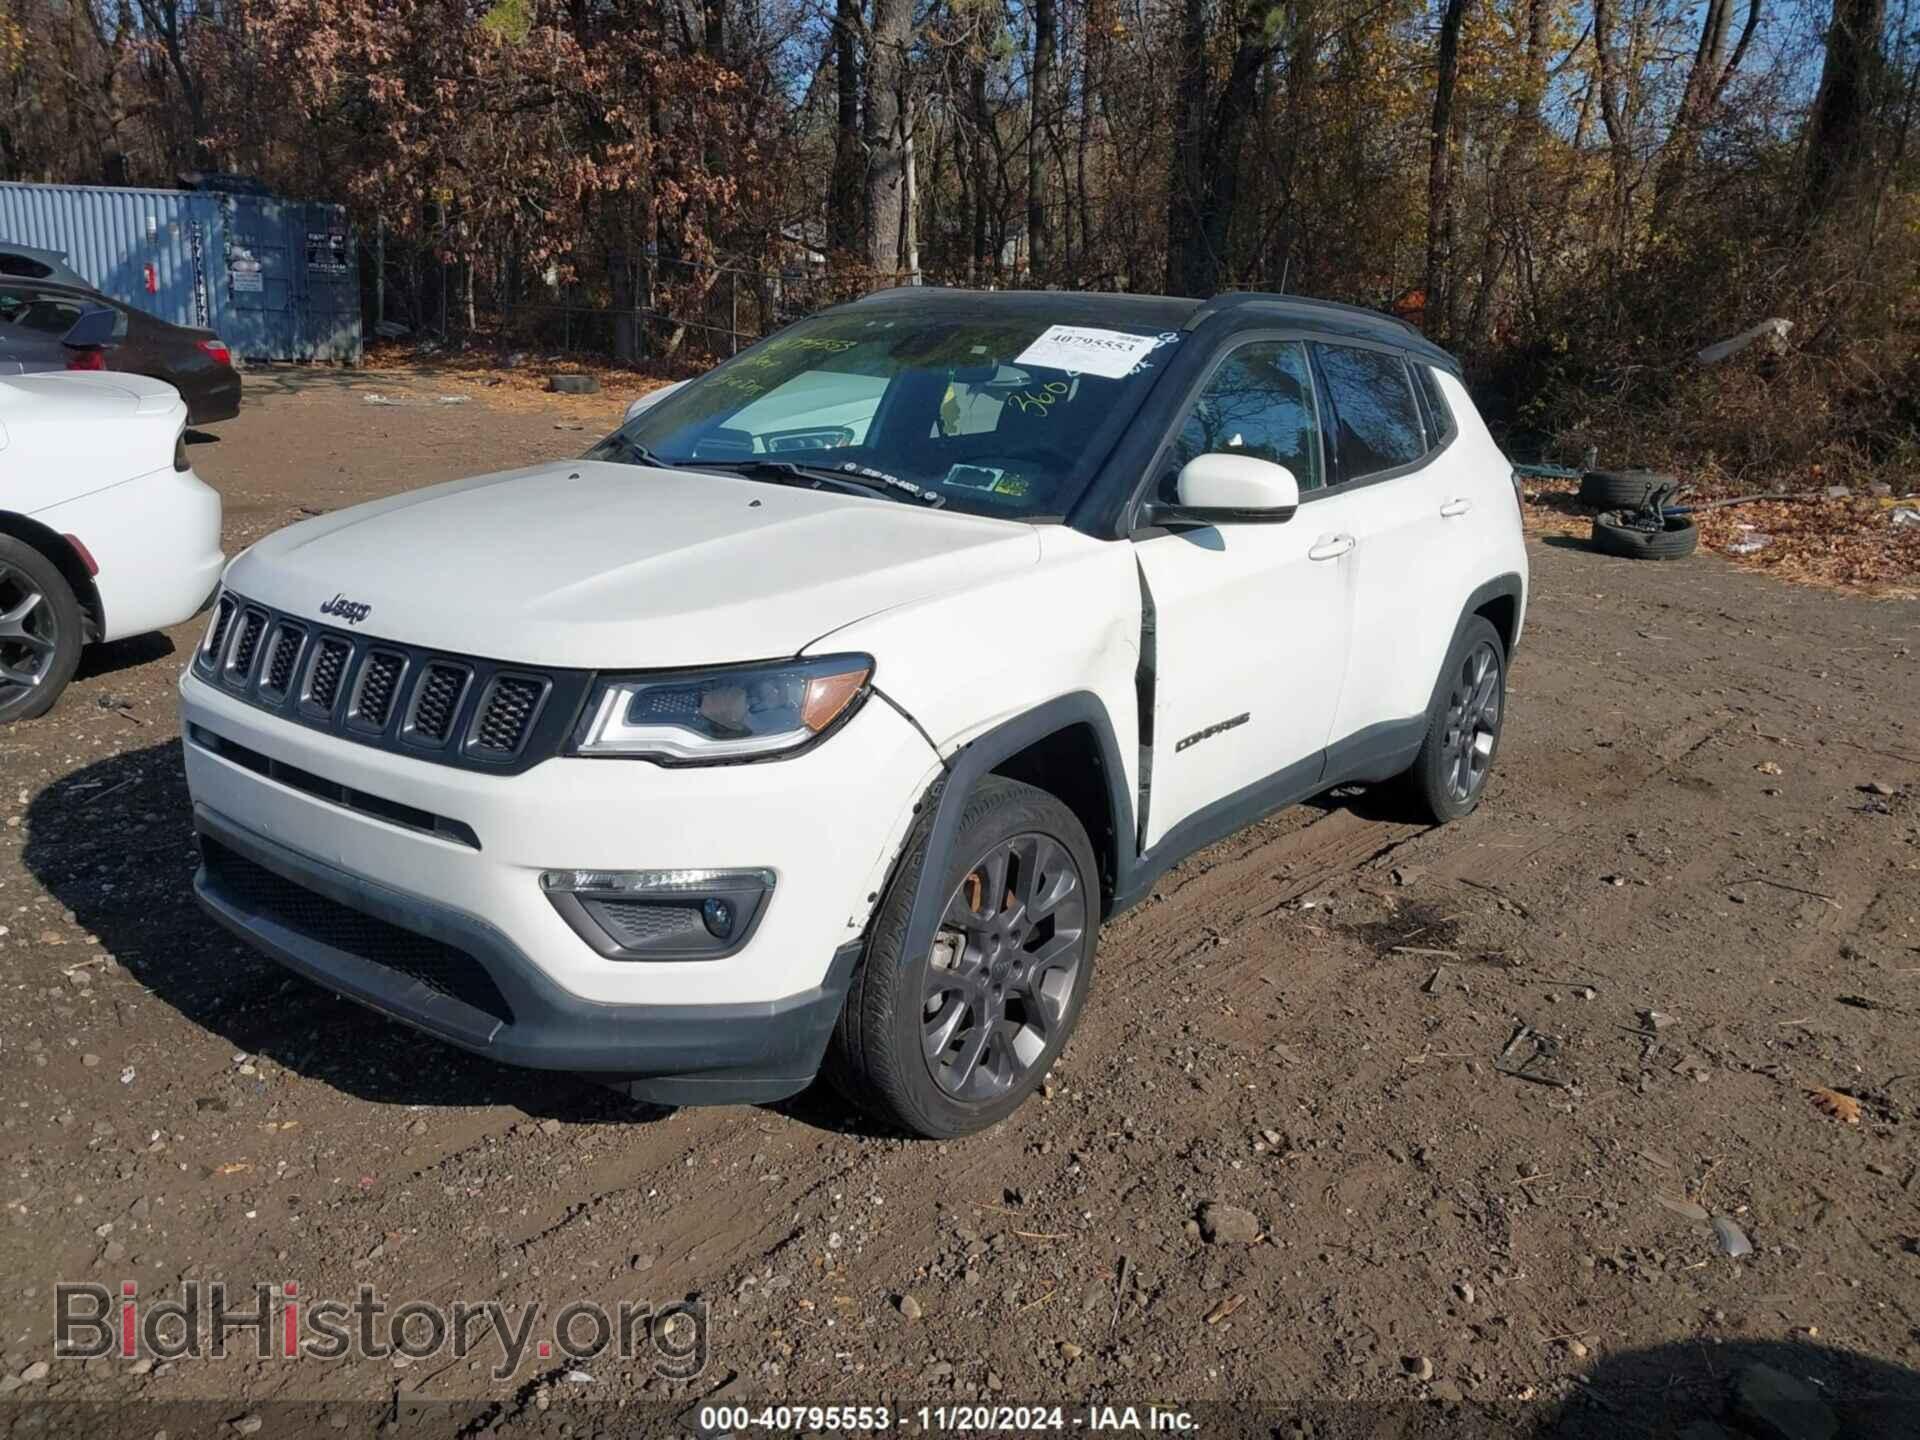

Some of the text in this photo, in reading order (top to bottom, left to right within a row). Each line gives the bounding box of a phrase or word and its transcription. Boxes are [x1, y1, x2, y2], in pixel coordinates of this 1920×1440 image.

[1008, 381, 1069, 417] 360
[320, 592, 372, 625] Jeep
[1175, 711, 1251, 753] COMPASS
